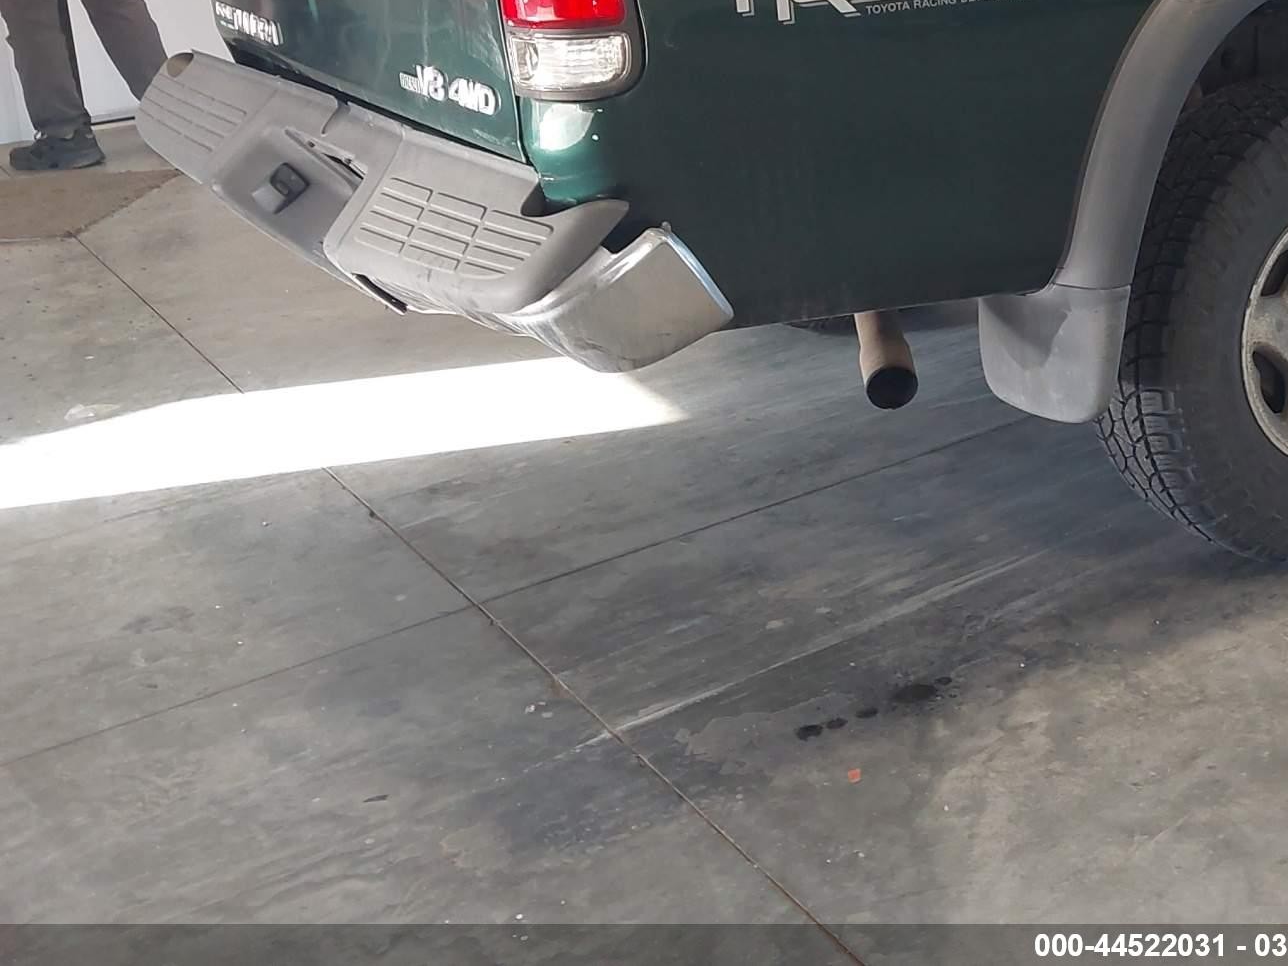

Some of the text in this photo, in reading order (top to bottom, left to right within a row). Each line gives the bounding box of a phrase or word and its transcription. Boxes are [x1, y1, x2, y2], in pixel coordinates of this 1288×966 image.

[866, 1, 910, 15] TOYOTA
[416, 64, 446, 102] V8
[448, 77, 498, 116] 4WD
